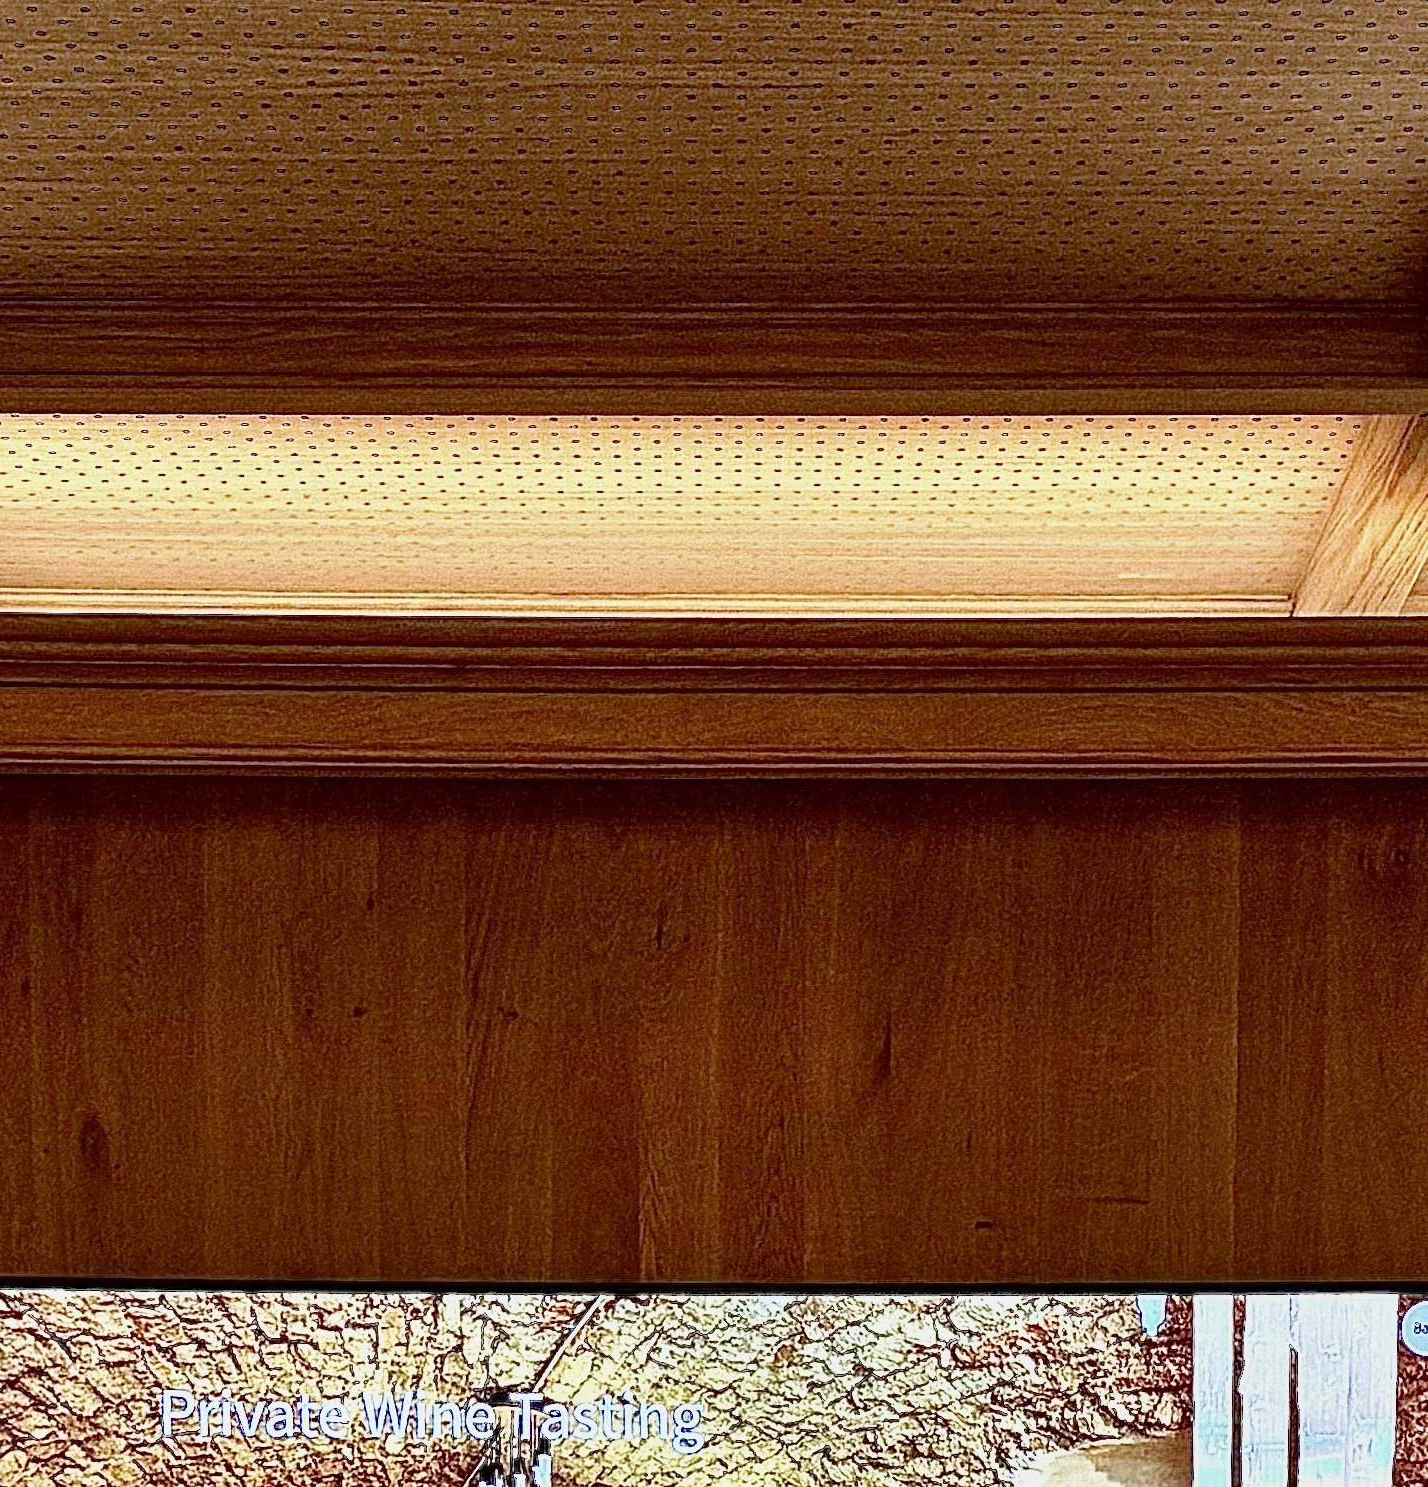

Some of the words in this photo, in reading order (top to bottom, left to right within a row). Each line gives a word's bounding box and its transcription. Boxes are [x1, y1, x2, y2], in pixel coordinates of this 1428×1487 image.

[159, 1387, 351, 1440] Private
[363, 1387, 496, 1441] Wine
[512, 1389, 706, 1456] Tasting
